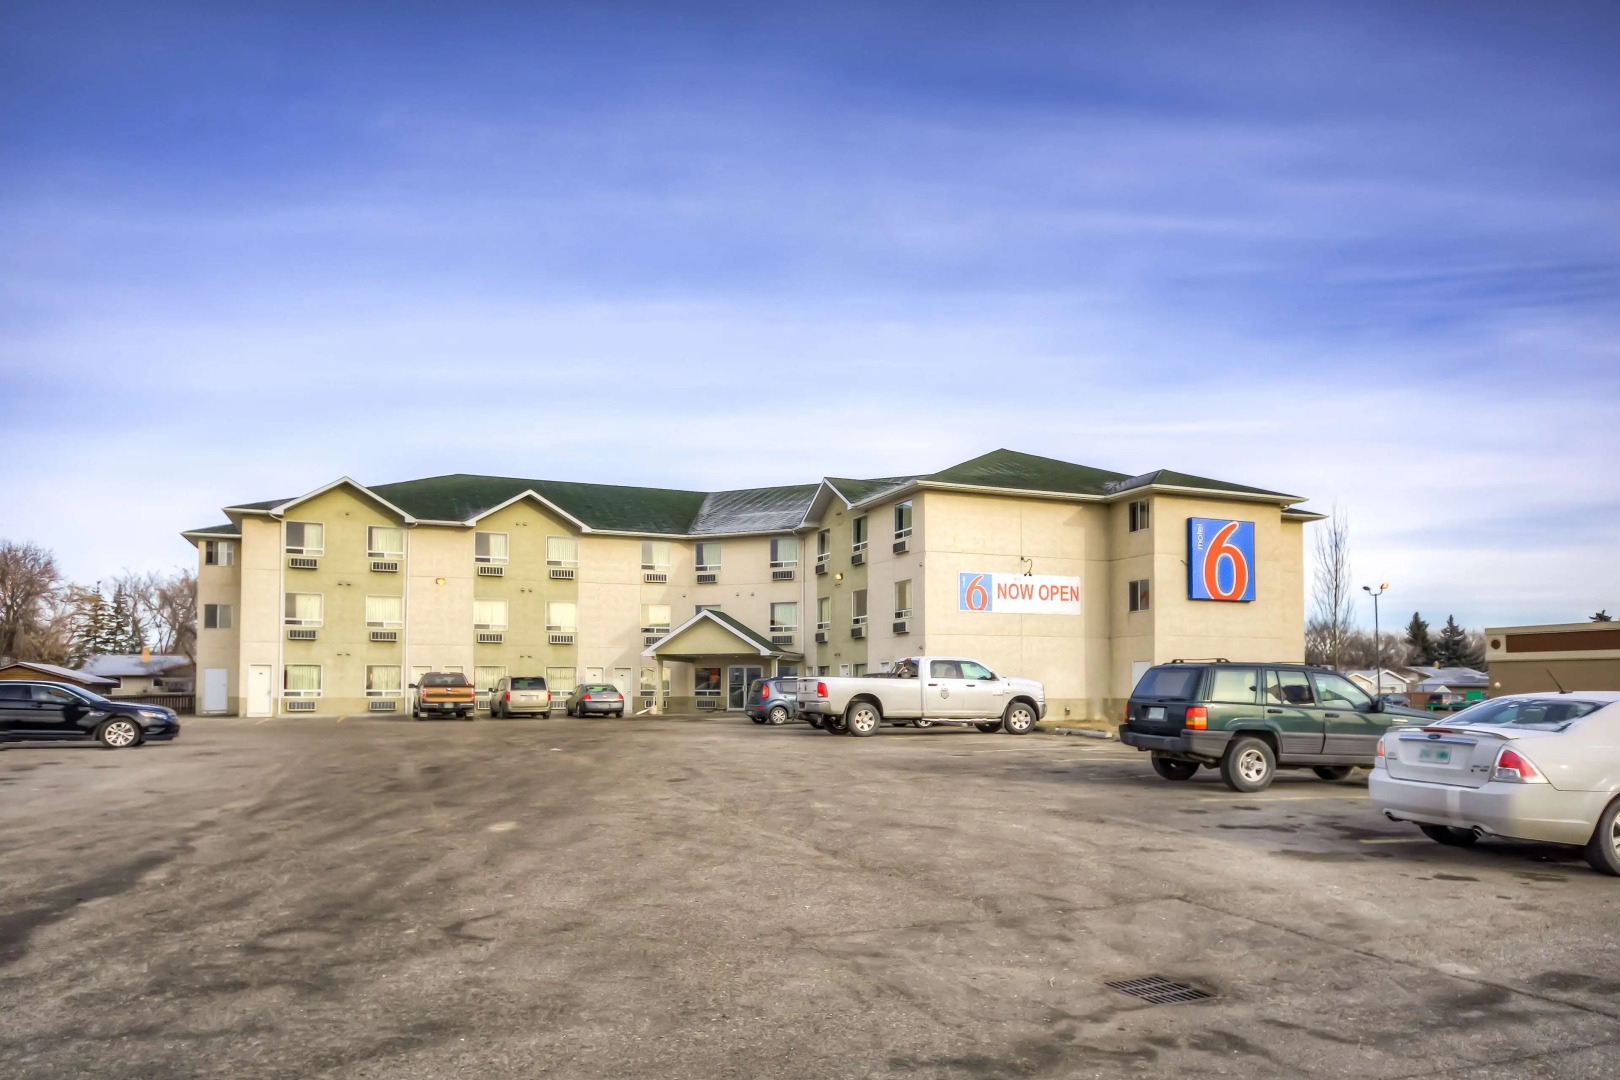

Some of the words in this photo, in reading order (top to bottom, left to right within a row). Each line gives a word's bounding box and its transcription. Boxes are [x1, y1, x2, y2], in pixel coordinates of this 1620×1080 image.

[1196, 523, 1204, 550] motel
[1203, 521, 1249, 601] 6
[965, 574, 989, 611] 6
[997, 583, 1034, 600] NOW
[1038, 584, 1080, 602] OPEN
